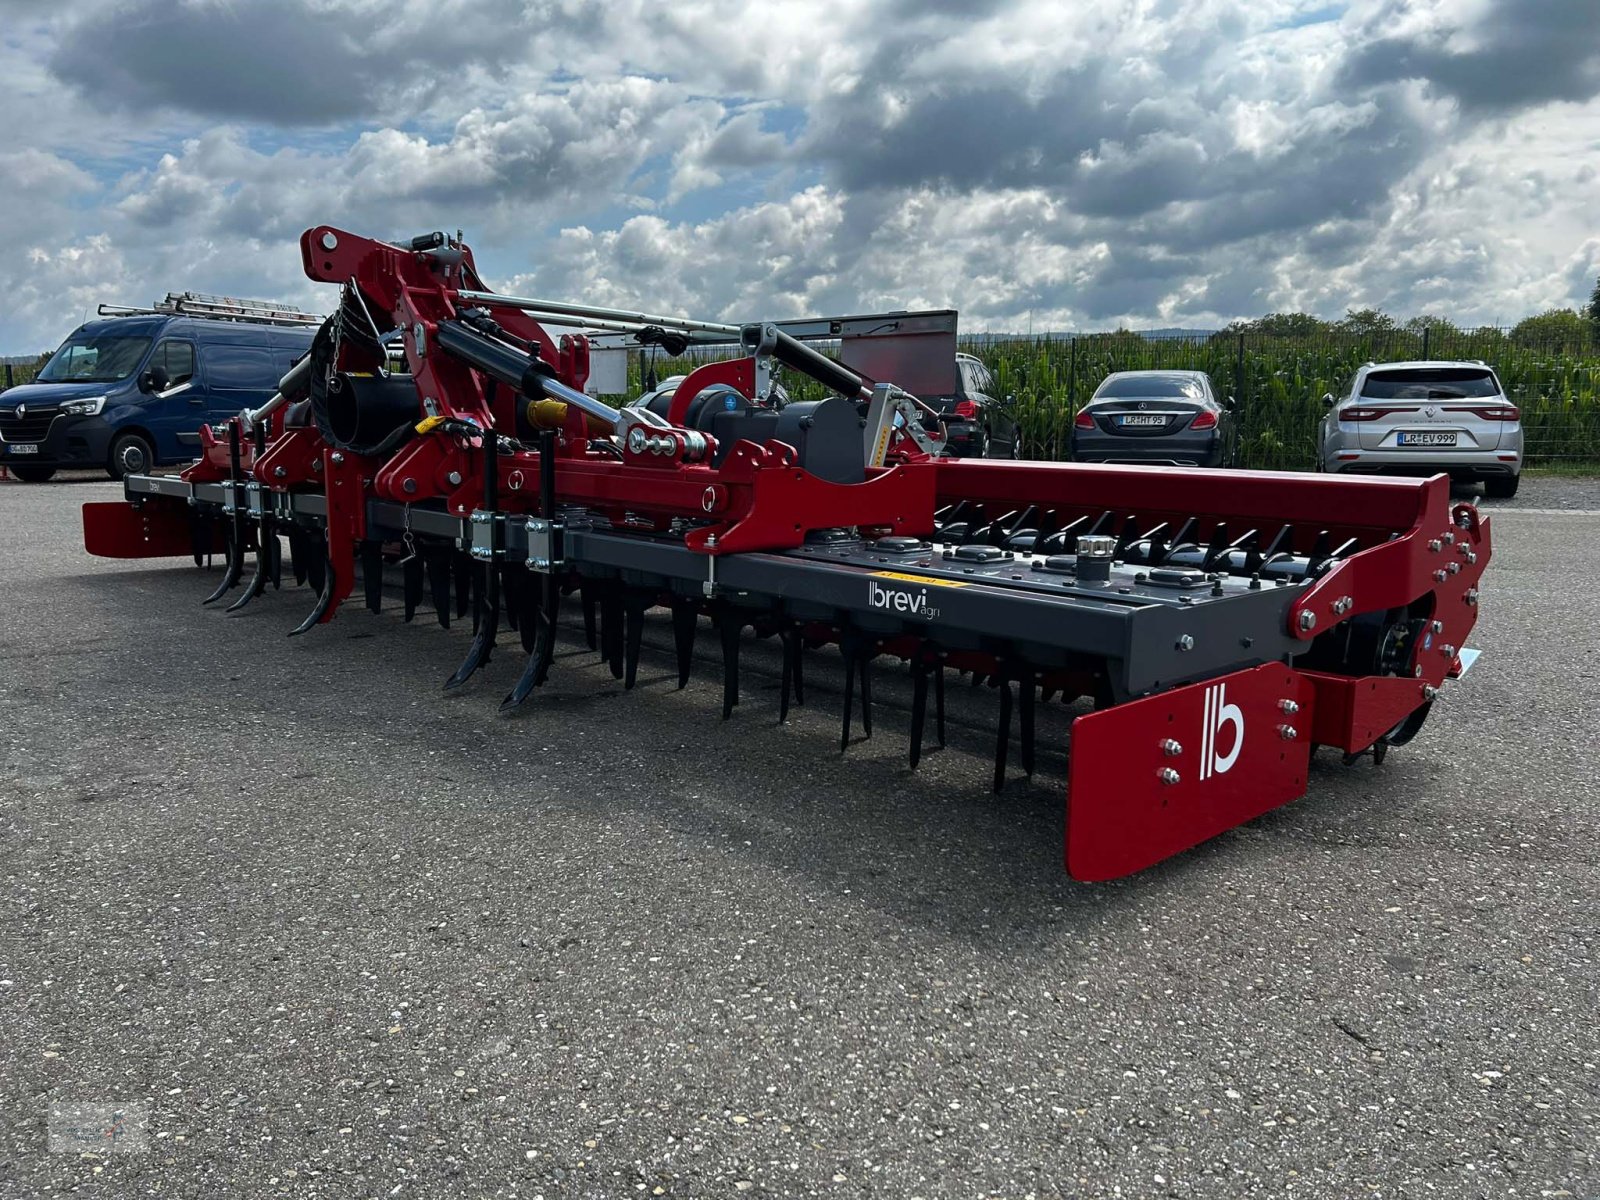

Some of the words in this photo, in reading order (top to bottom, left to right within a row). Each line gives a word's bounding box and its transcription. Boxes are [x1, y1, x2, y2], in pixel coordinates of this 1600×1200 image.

[1125, 416, 1136, 424] LR
[1140, 416, 1151, 424] HT
[1152, 416, 1163, 424] 95
[1404, 434, 1416, 443] LR
[1422, 434, 1436, 443] EV
[1437, 434, 1455, 443] 999
[920, 606, 940, 620] agri
